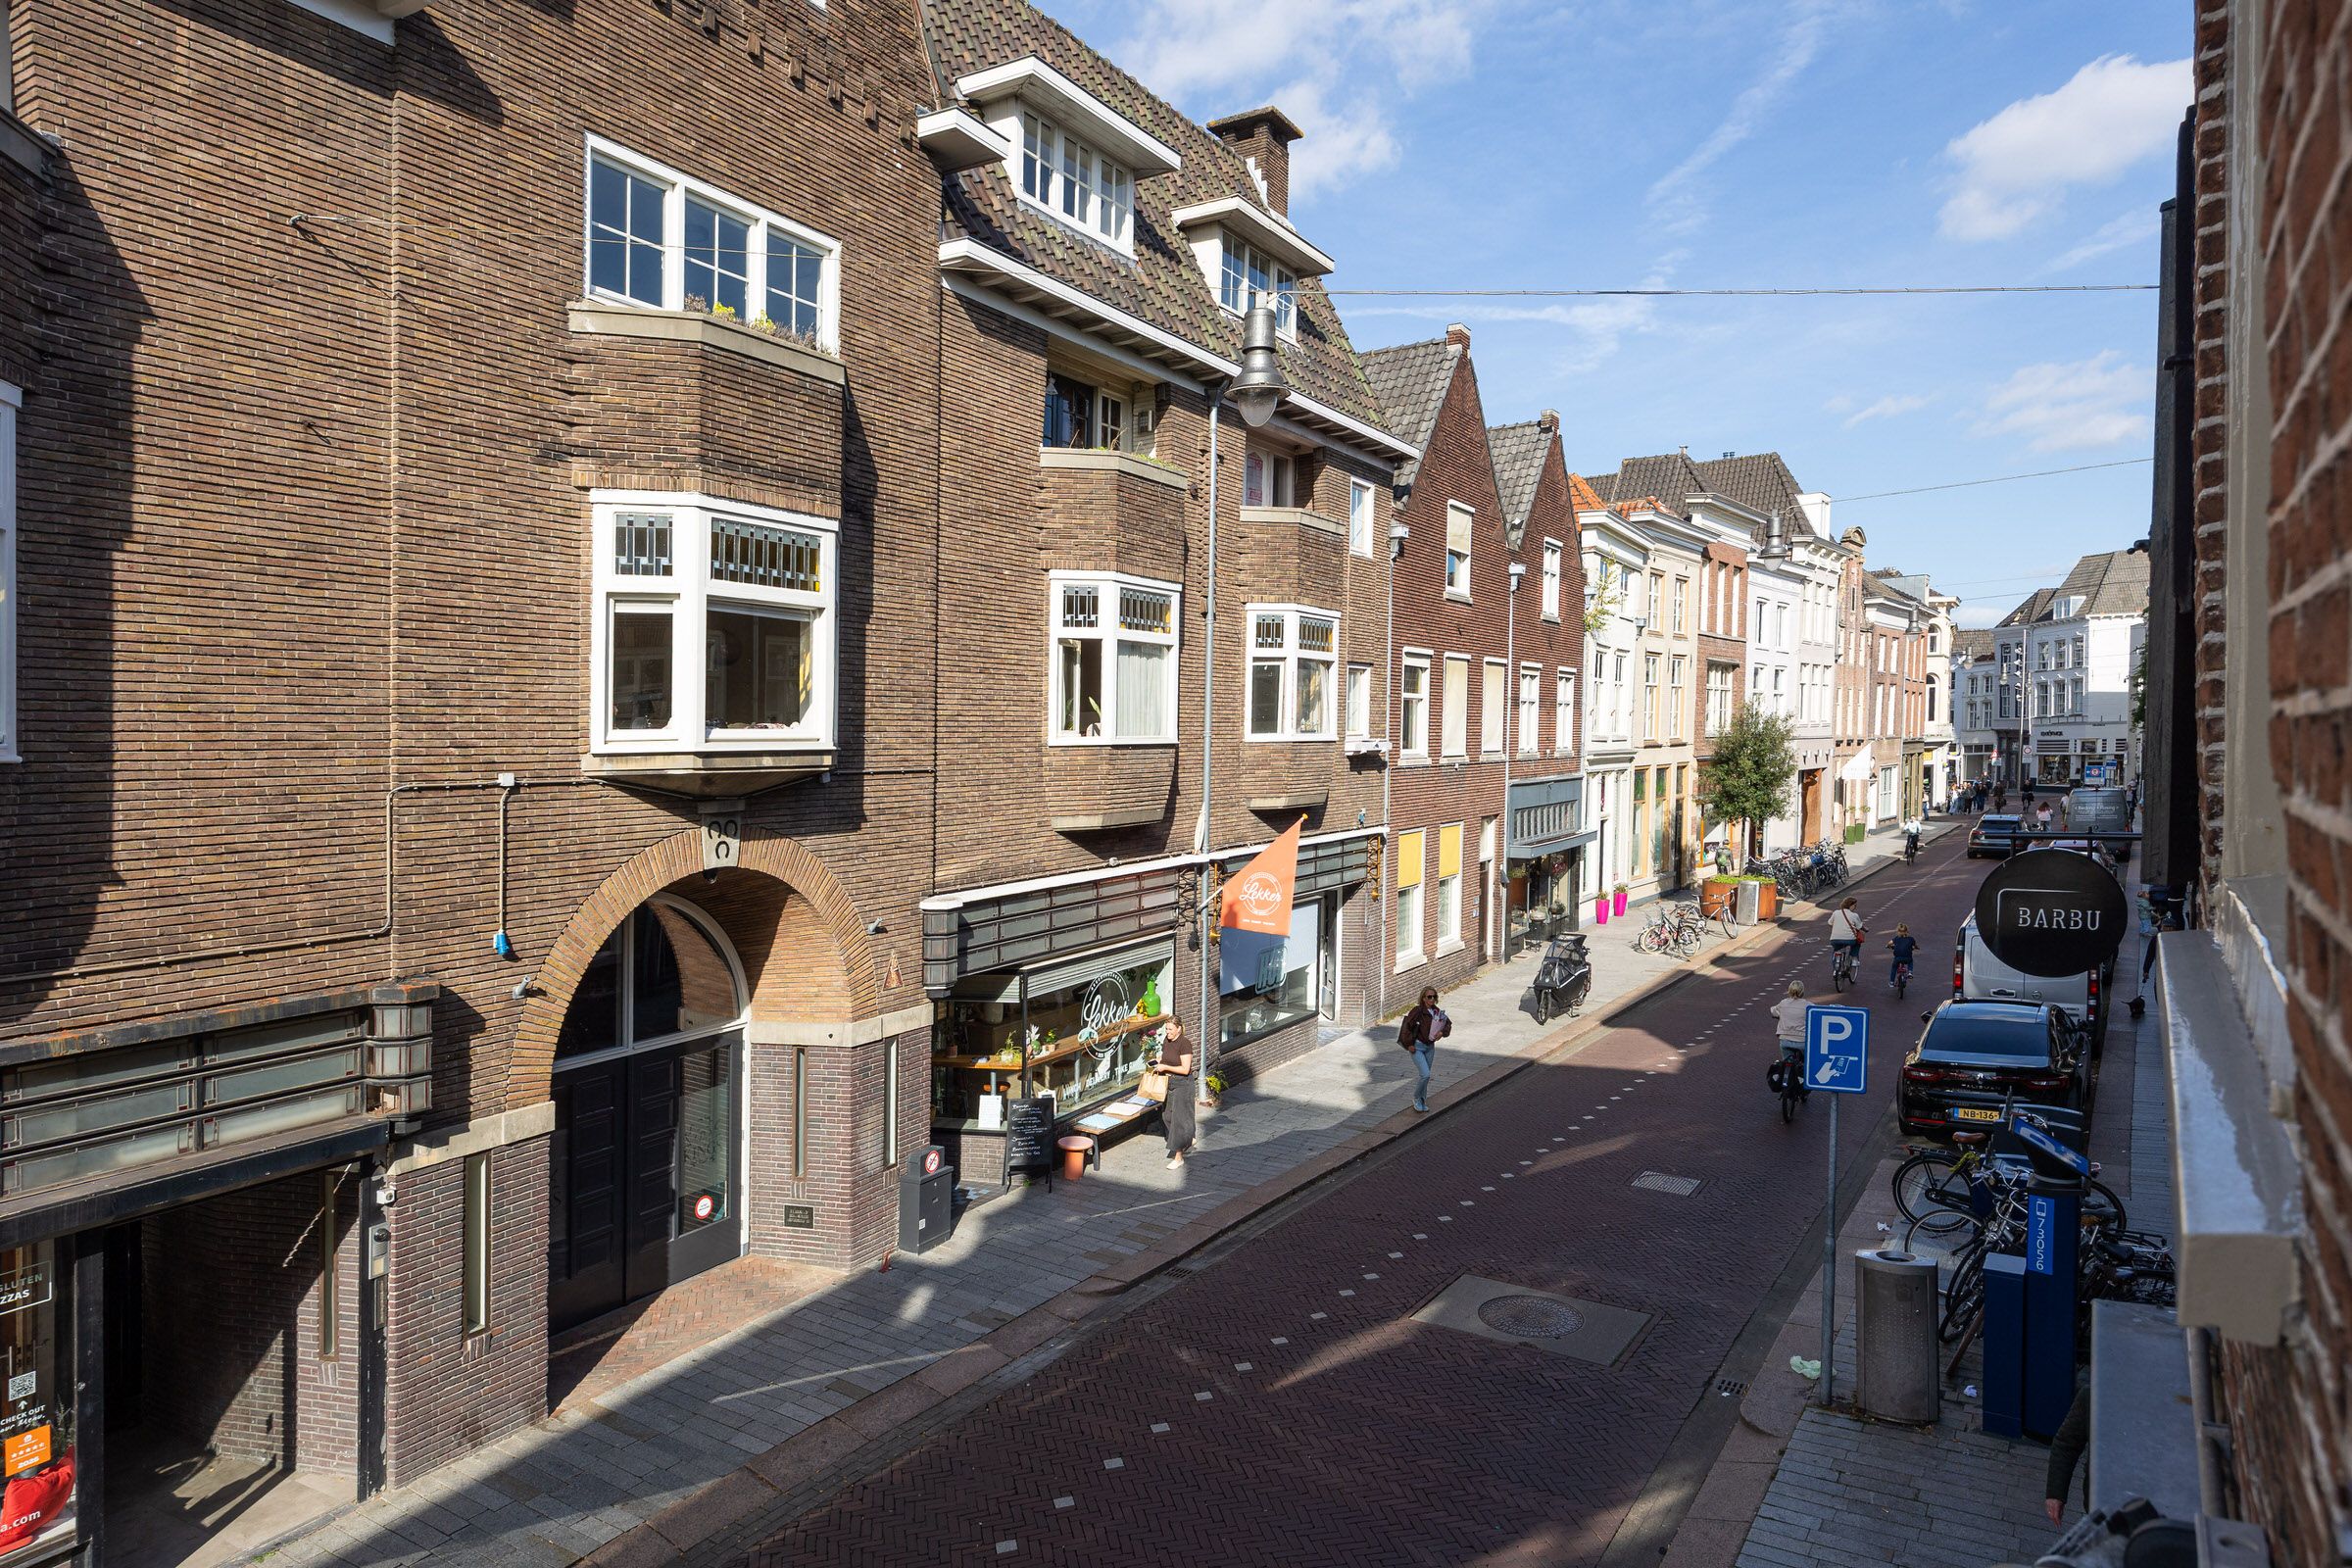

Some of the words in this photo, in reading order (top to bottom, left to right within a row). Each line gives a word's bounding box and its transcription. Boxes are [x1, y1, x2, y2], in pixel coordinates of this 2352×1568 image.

[1239, 882, 1281, 906] Lekker
[2018, 907, 2101, 931] BARBU
[1078, 994, 1130, 1044] Lekker
[1820, 1015, 1853, 1055] P
[1963, 1109, 1999, 1120] NB-136-
[2035, 1217, 2046, 1271] 73056
[0, 1411, 27, 1426] CHECK
[28, 1404, 46, 1416] OUT
